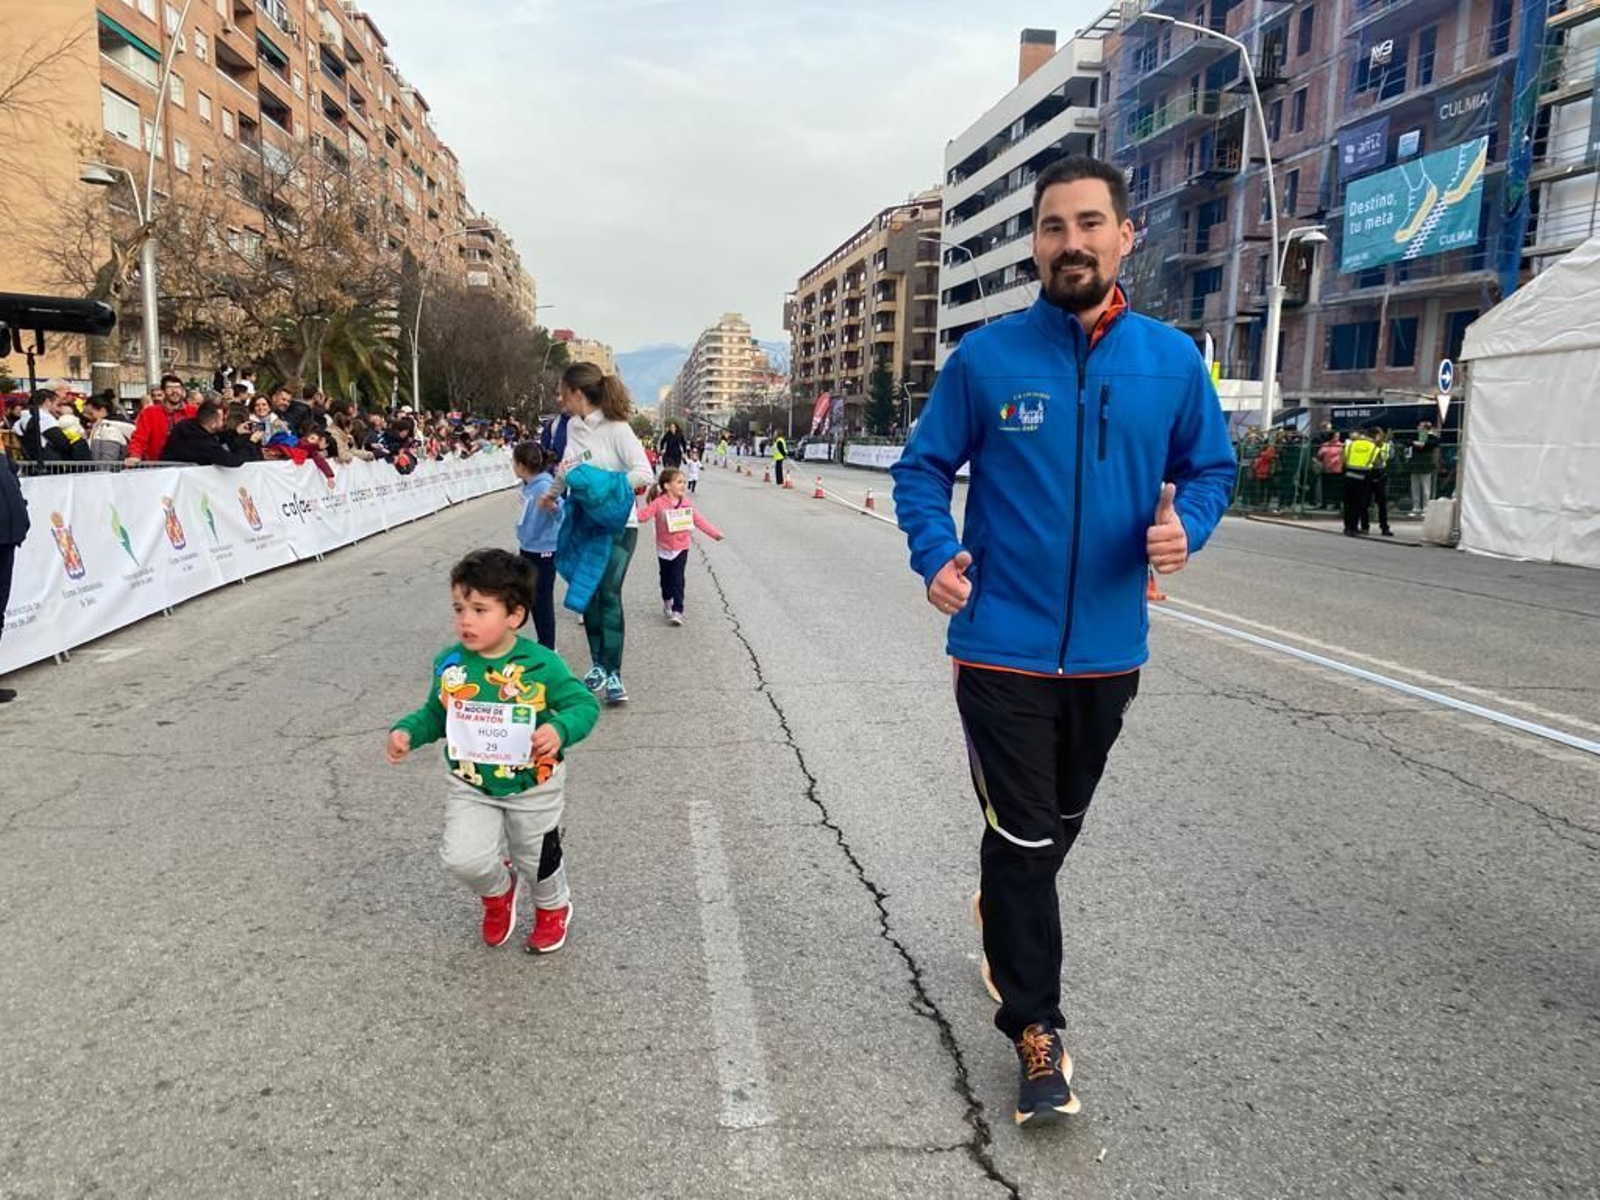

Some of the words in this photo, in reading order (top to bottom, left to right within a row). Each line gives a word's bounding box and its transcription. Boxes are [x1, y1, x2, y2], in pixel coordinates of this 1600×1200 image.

[1440, 92, 1489, 120] CULMIA
[1349, 193, 1397, 217] Destino,
[1350, 221, 1361, 235] tu
[1365, 212, 1394, 231] meta
[456, 711, 472, 720] SAN
[464, 706, 491, 715] NOCHE
[493, 708, 504, 716] DE
[478, 728, 508, 737] HUGO
[486, 742, 498, 752] 29
